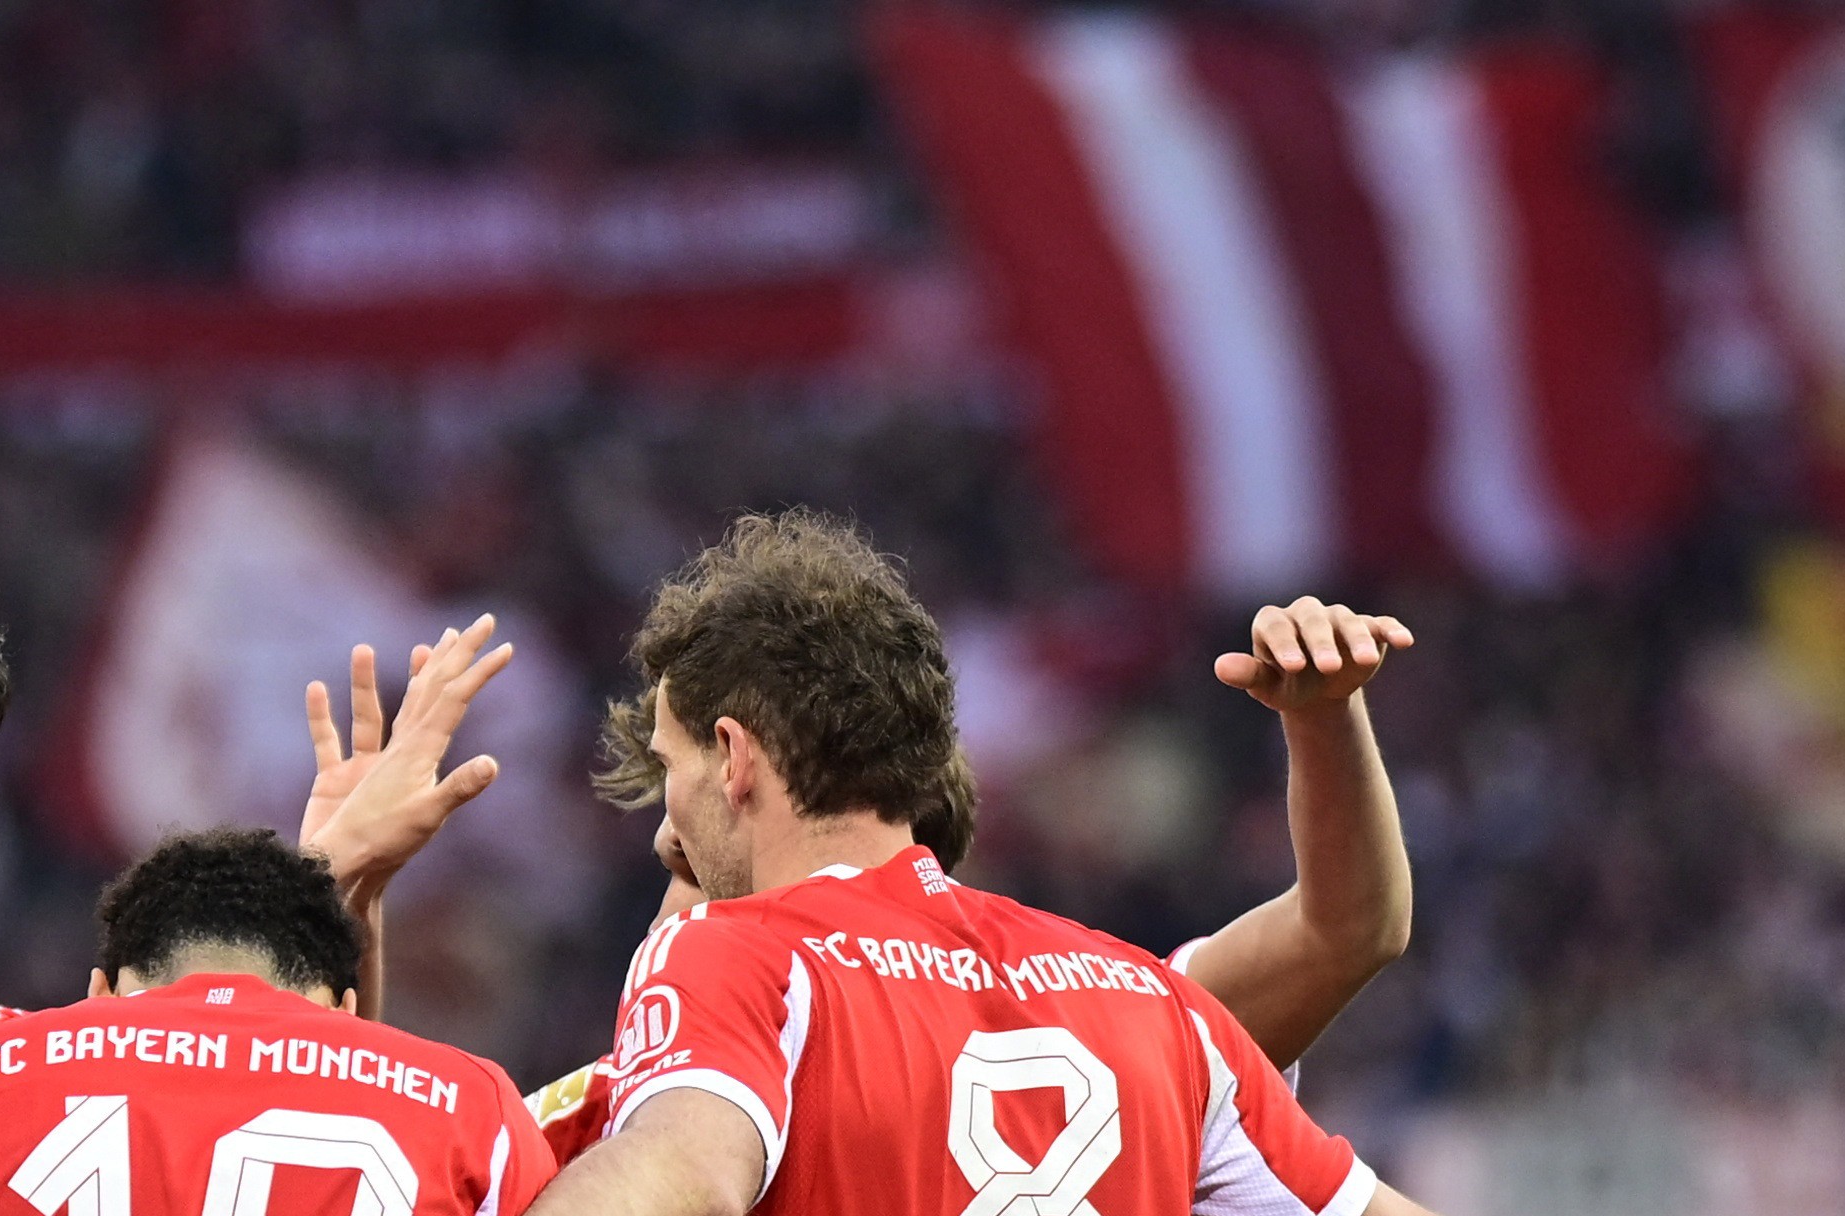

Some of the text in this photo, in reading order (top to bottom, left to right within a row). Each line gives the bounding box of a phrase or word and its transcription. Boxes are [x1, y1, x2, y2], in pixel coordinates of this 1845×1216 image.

[912, 857, 938, 873] MIA
[923, 881, 949, 897] MIA
[802, 931, 861, 969] FC
[1002, 952, 1170, 1001] MÜNCHEN
[45, 1026, 228, 1068] BAYERN
[249, 1038, 459, 1113] MÜNCHEN
